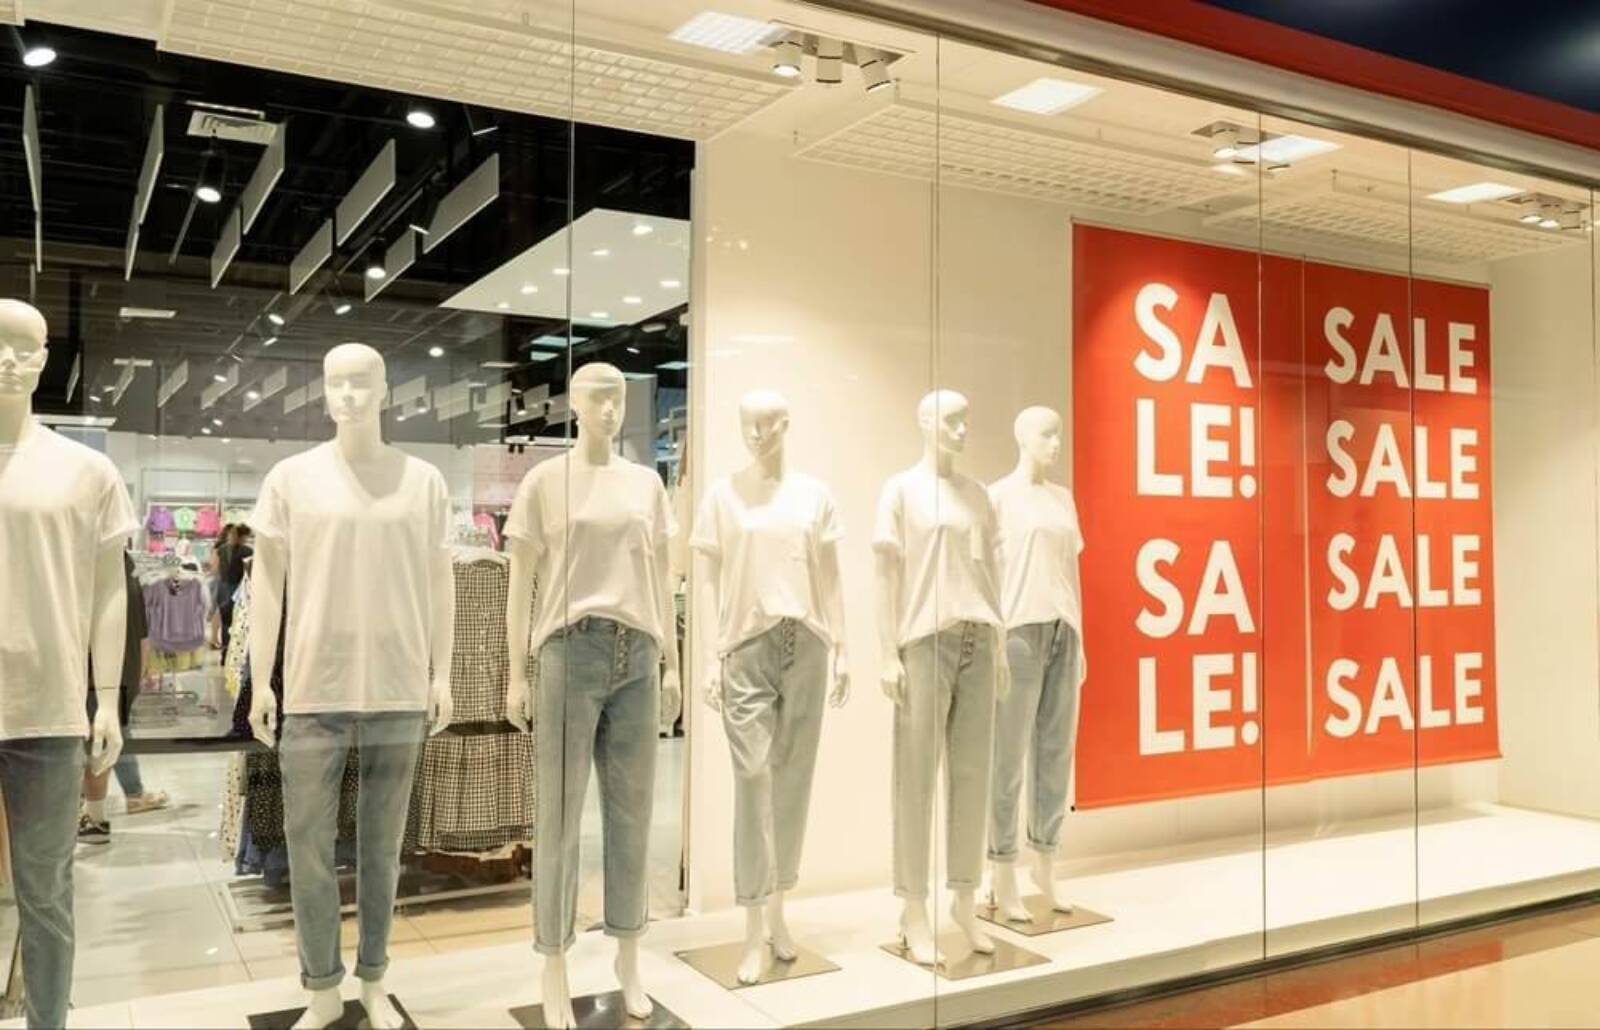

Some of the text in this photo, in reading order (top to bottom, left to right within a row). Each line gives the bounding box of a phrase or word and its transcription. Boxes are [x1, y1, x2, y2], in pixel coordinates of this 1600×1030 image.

[1133, 282, 1253, 389] SA
[1324, 306, 1478, 394] SALE
[1135, 398, 1256, 499] LE!
[1326, 419, 1480, 500] SALE
[1135, 538, 1255, 638] SA
[1327, 532, 1482, 611] SALE
[1138, 652, 1260, 756] LE!
[1324, 652, 1484, 738] SALE
